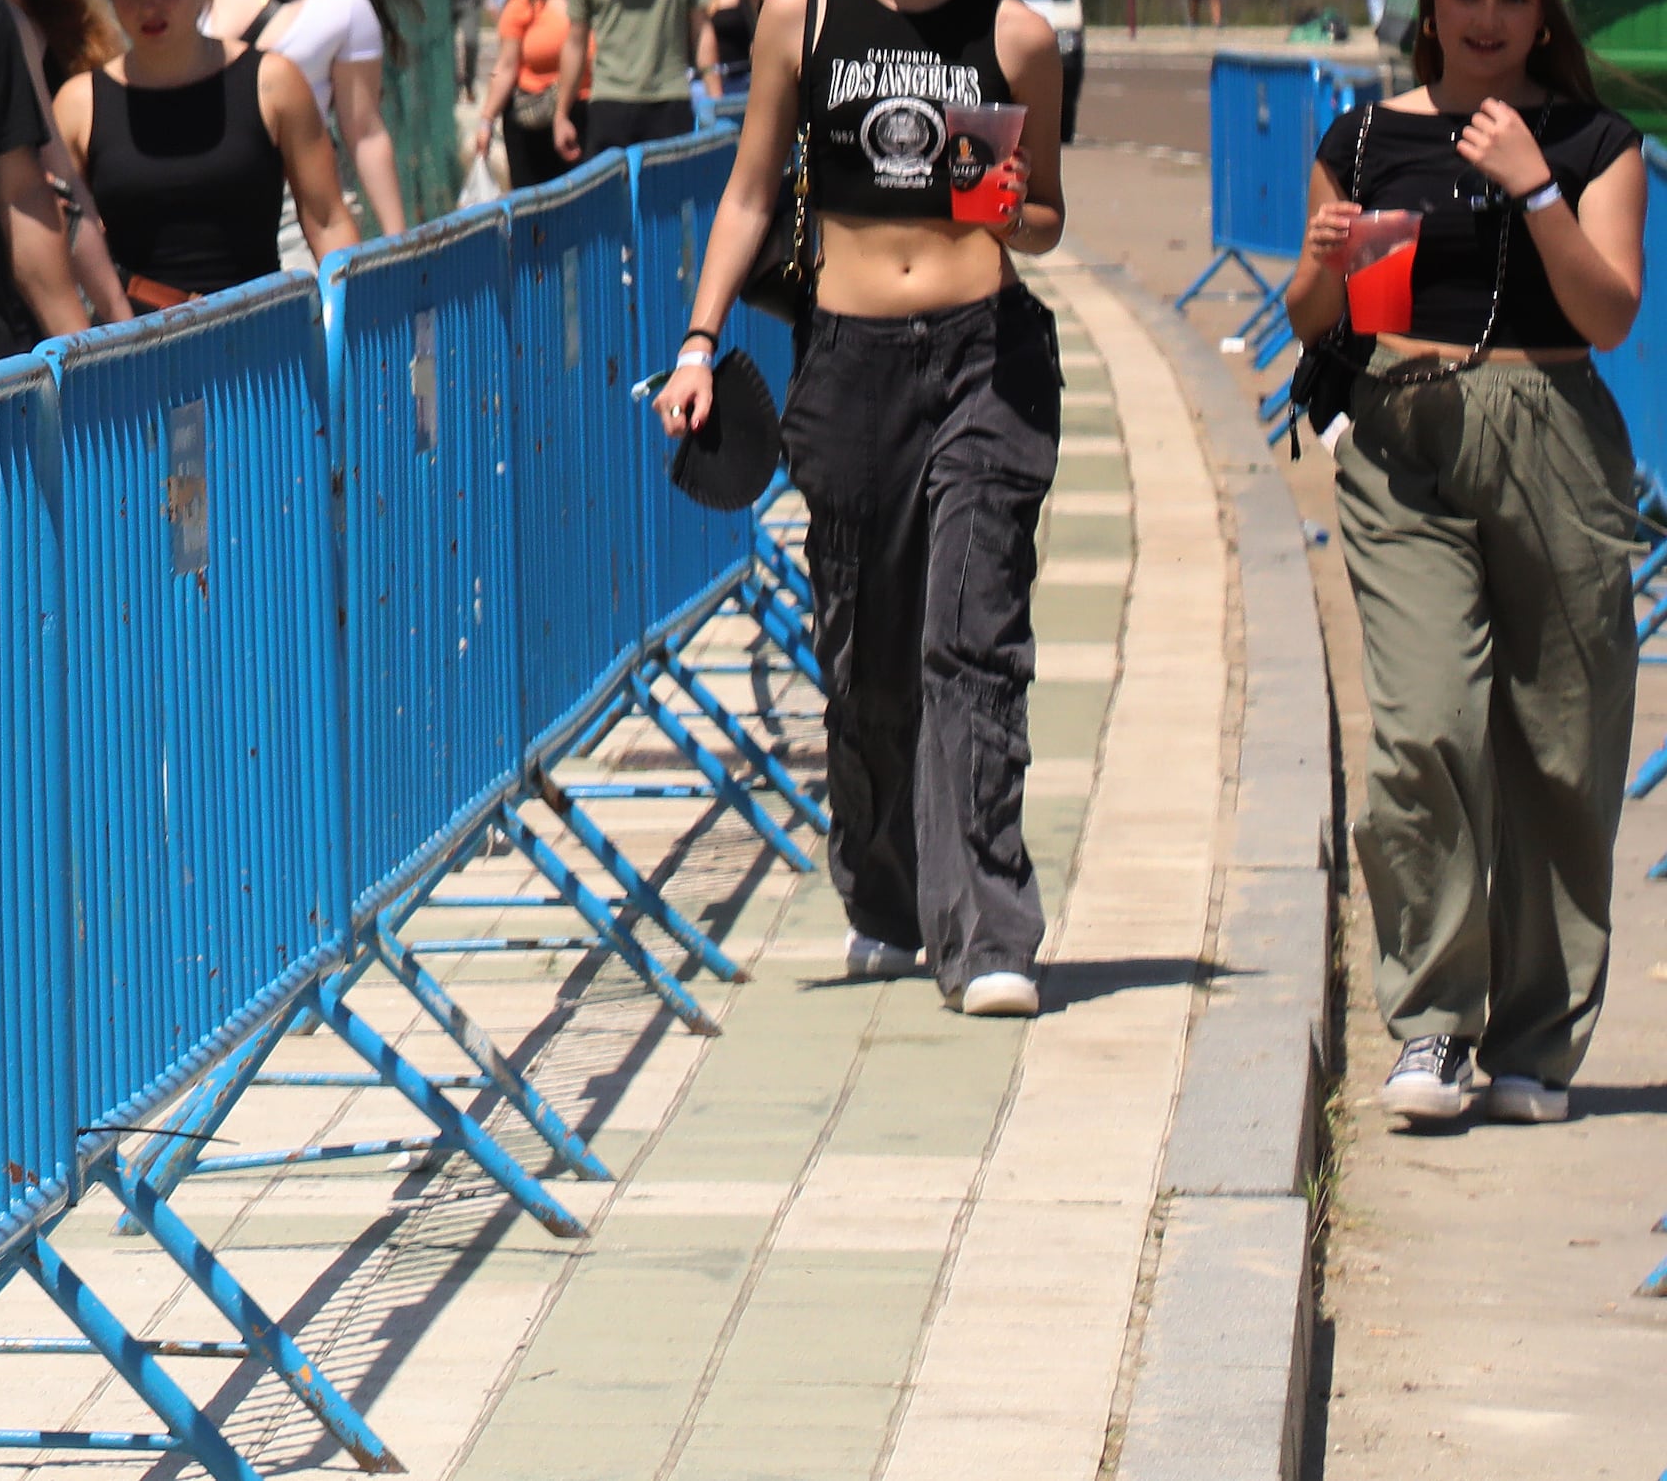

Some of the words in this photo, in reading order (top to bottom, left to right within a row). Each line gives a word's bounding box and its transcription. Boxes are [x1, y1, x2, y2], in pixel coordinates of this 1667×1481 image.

[867, 48, 942, 64] CALIFORNIA
[827, 58, 876, 111] LOS
[876, 63, 982, 107] ANGELES
